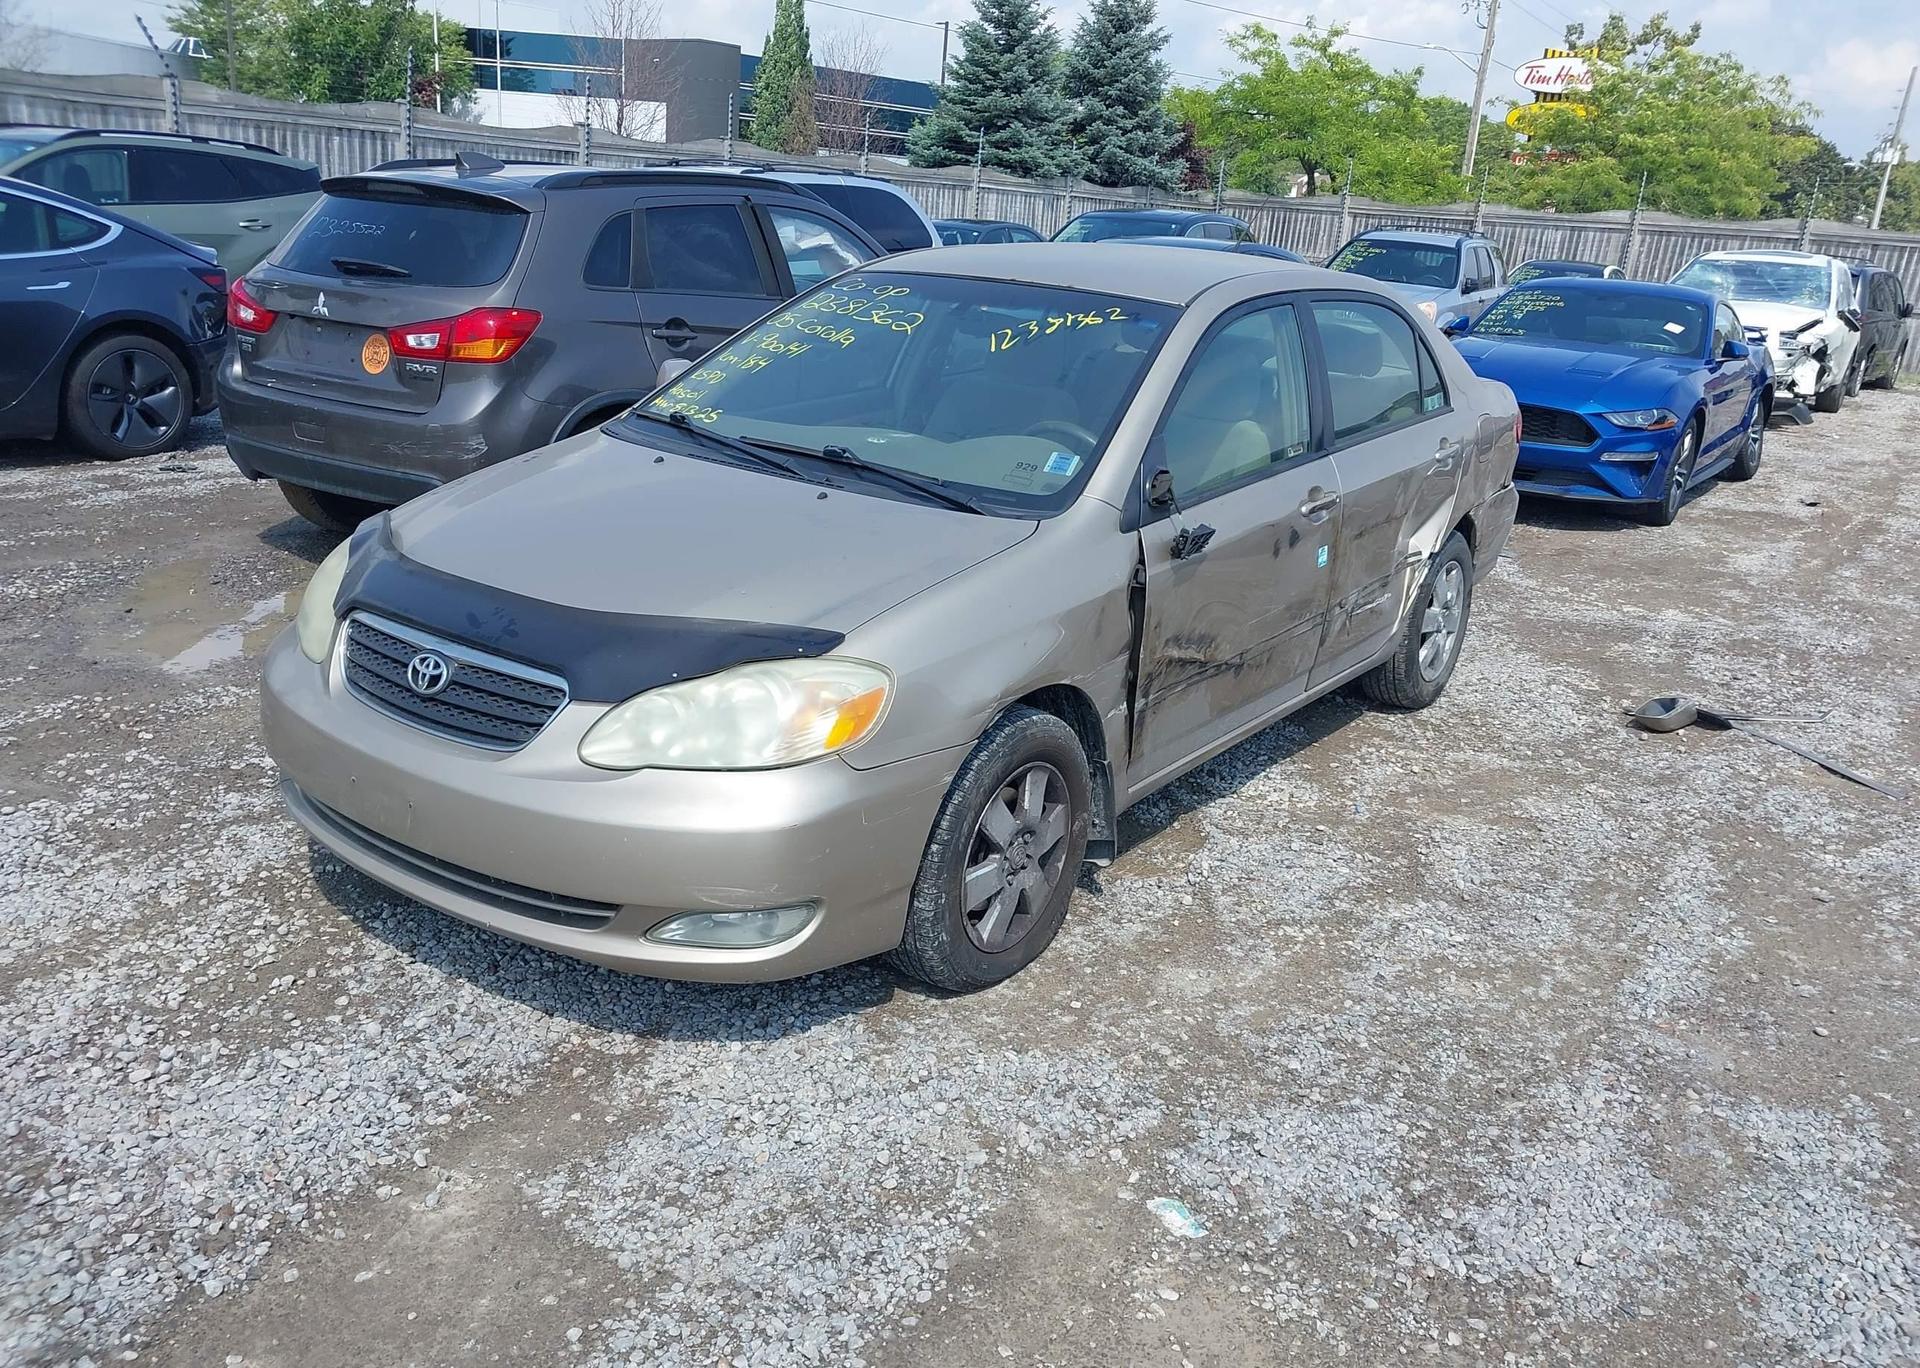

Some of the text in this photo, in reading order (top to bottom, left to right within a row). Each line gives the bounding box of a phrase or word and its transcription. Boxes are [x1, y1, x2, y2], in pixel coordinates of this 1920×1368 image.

[1523, 65, 1552, 85] Tim
[766, 312, 856, 348] 05 Corolla
[405, 362, 438, 374] RVR
[1015, 461, 1039, 472] 929
